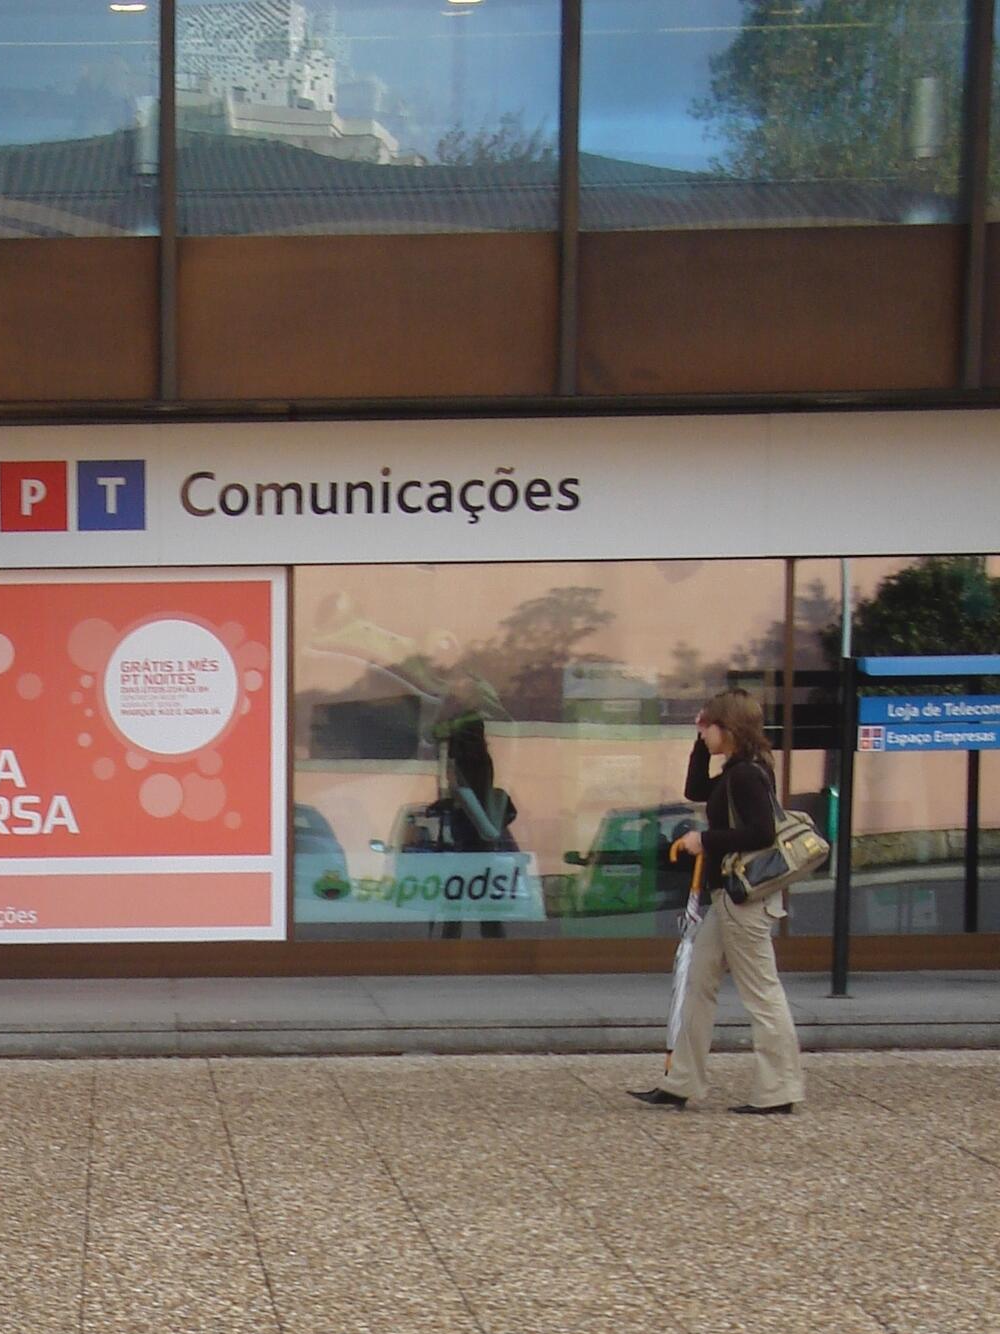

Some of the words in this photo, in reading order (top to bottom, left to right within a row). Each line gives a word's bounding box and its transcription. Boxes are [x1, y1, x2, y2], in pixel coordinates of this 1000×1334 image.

[20, 477, 127, 516] PT
[181, 466, 581, 525] Comunicações
[121, 658, 173, 673] GRÁTIS
[121, 674, 140, 685] PT
[144, 673, 196, 685] NOITES
[887, 703, 919, 720] Loja
[922, 702, 941, 716] de
[887, 731, 932, 746] Espaço
[934, 730, 996, 745] Empresas
